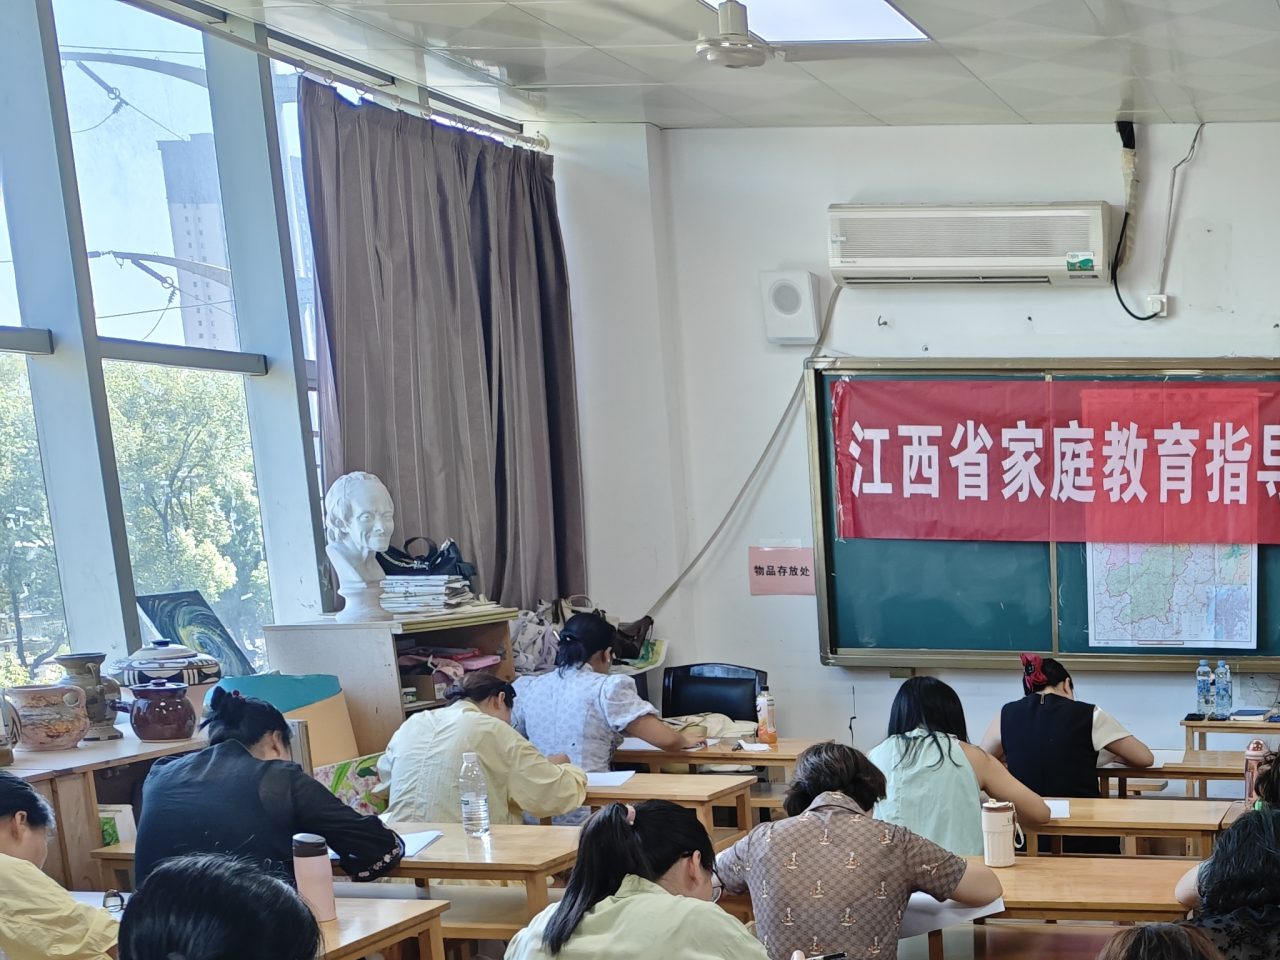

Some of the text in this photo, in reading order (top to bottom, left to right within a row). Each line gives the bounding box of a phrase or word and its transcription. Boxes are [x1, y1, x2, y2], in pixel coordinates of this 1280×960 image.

[753, 565, 810, 577] 物品存放处
